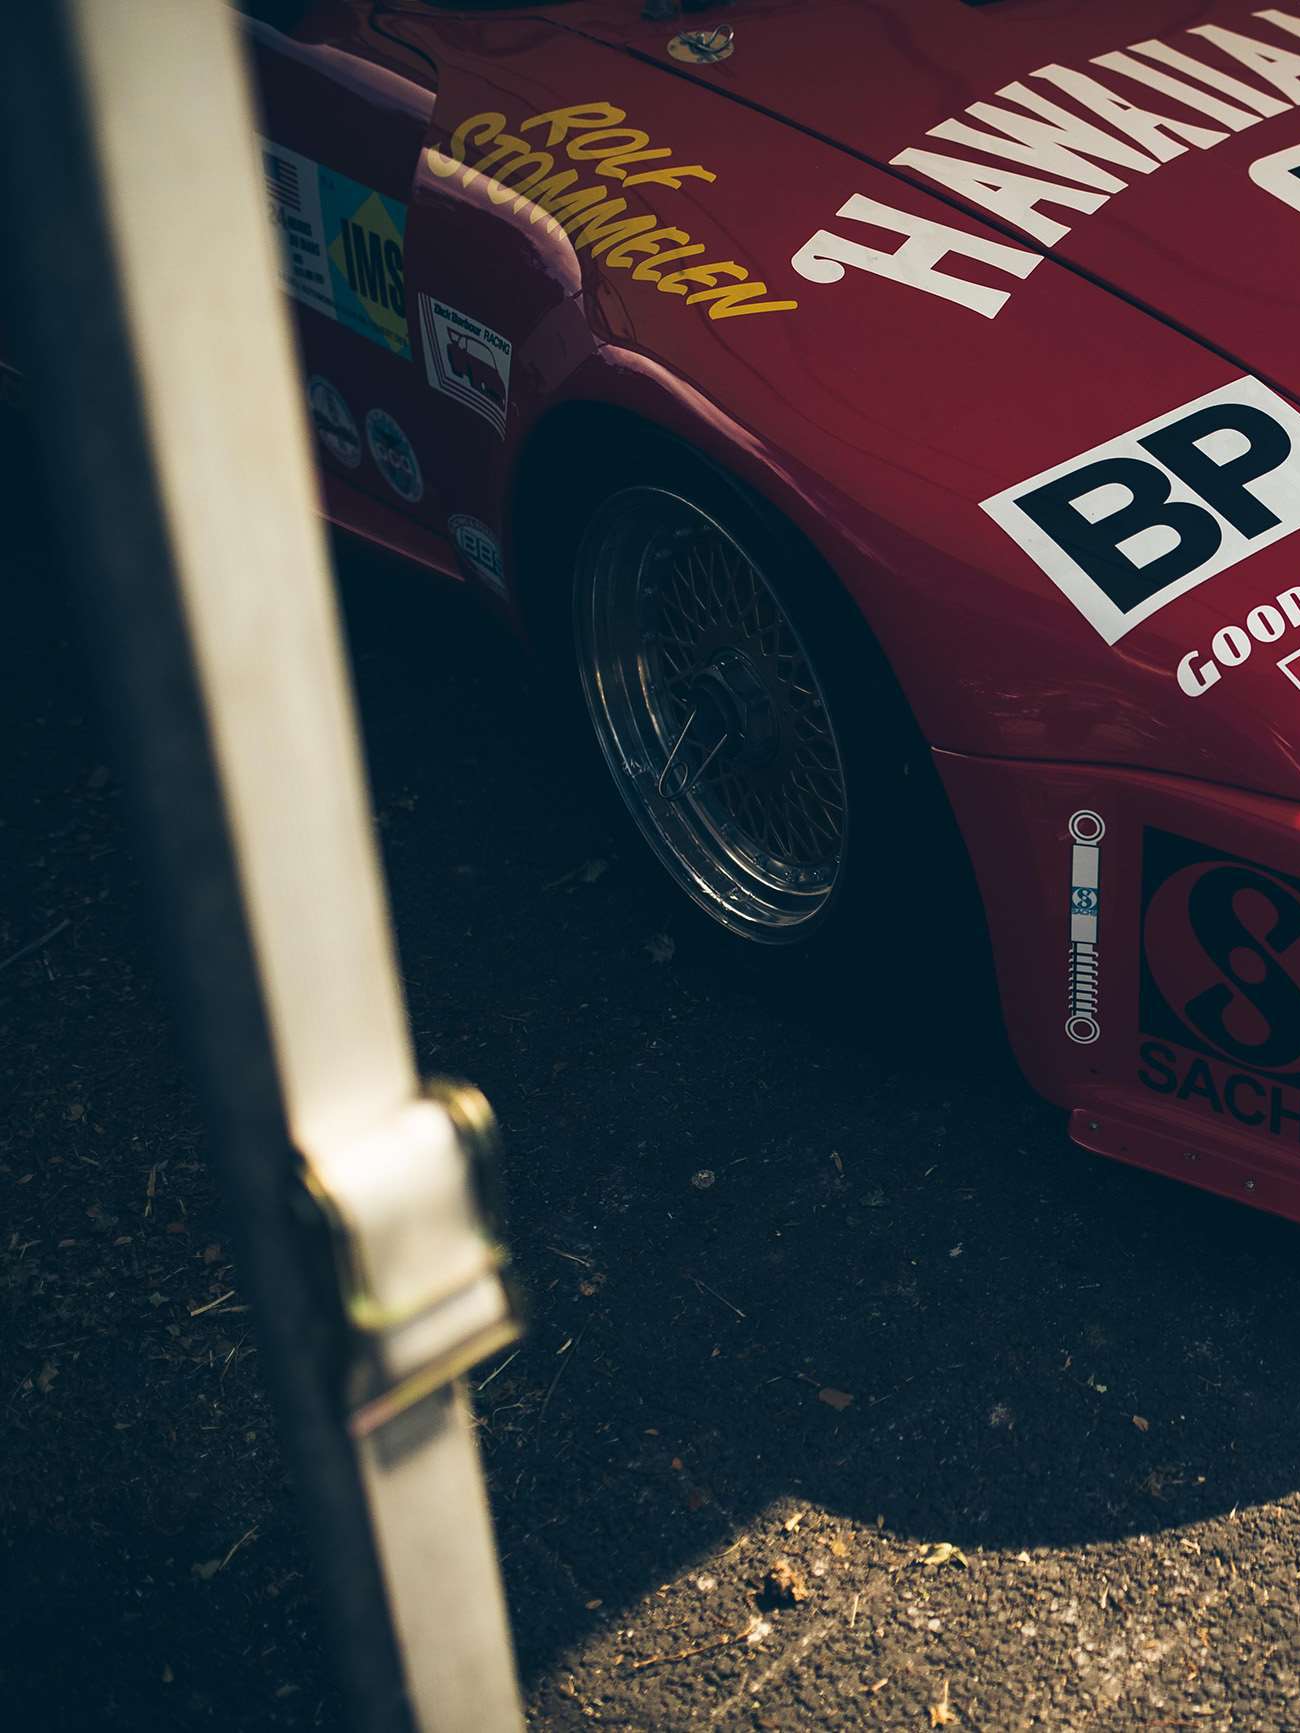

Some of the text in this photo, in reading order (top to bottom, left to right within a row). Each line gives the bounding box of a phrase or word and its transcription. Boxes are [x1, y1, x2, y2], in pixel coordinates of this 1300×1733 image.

[427, 112, 798, 319] STOMMELEN
[520, 102, 716, 189] ROLF
[484, 329, 510, 355] RACING
[1012, 403, 1292, 615] BP
